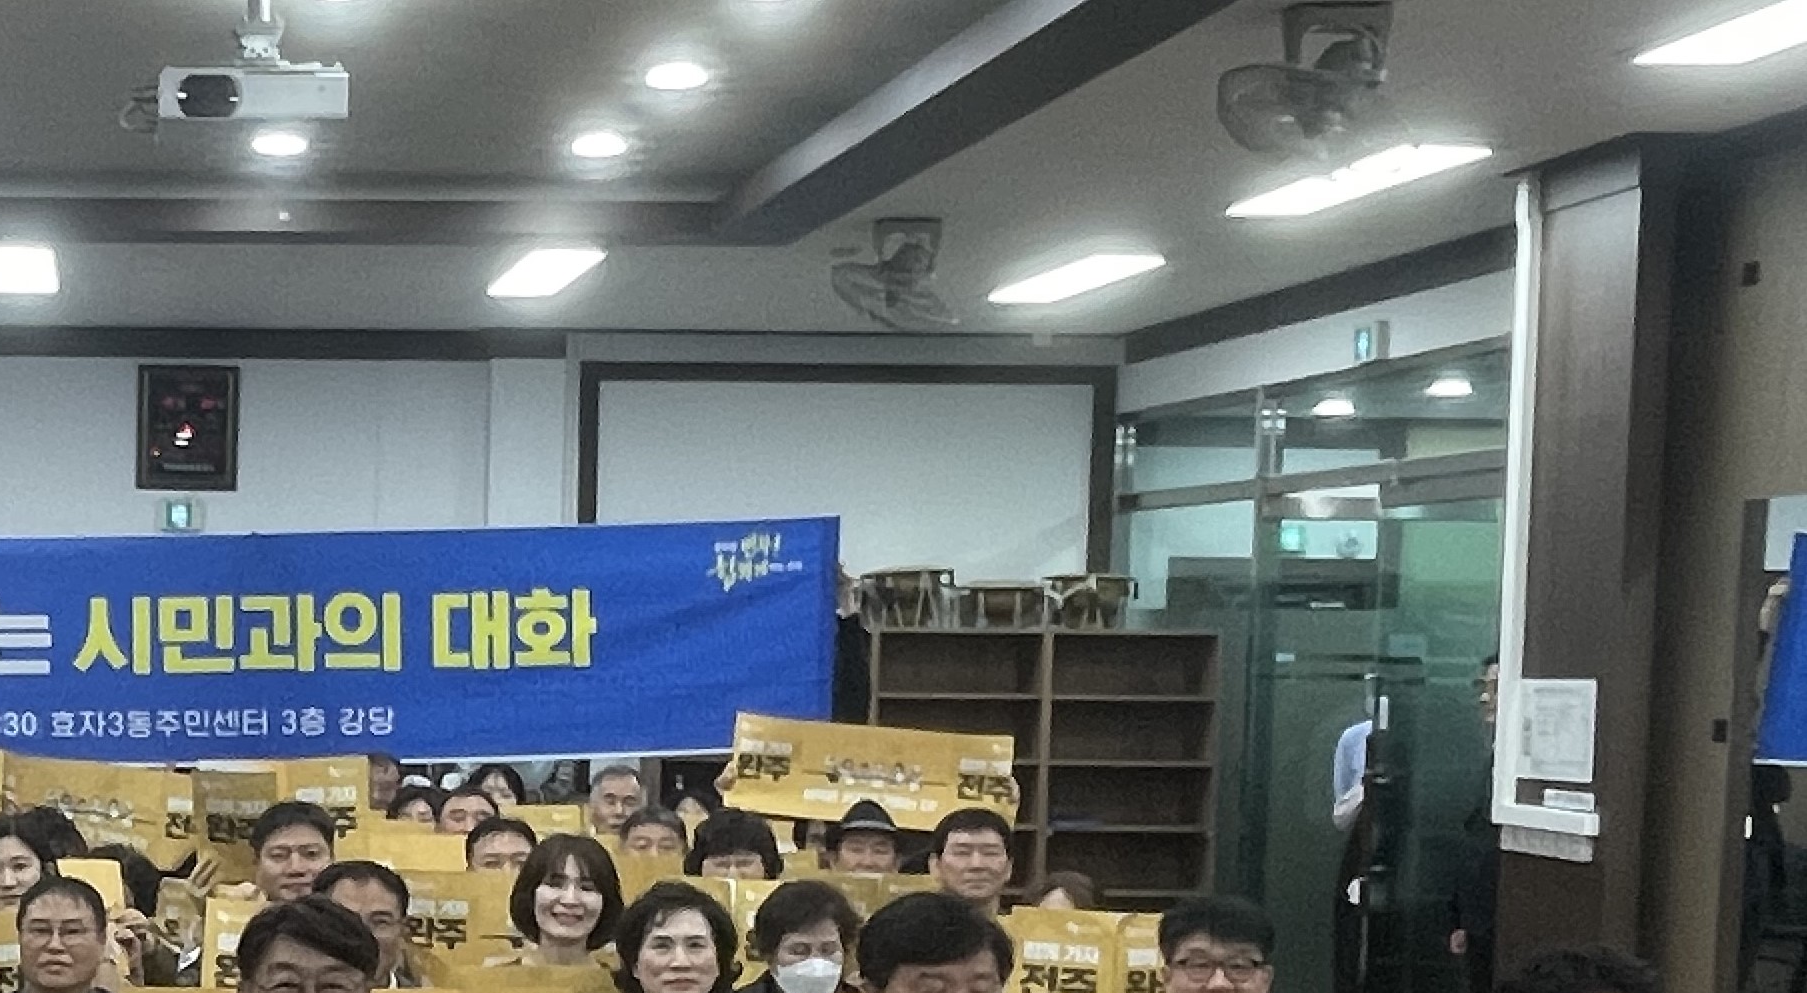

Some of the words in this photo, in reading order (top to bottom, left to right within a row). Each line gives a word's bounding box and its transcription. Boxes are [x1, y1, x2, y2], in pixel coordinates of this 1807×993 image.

[73, 592, 402, 674] 시민과의
[431, 587, 596, 670] 대화
[51, 710, 269, 738] 효자3동주민센터
[281, 706, 326, 736] 3층
[339, 706, 394, 736] 강당
